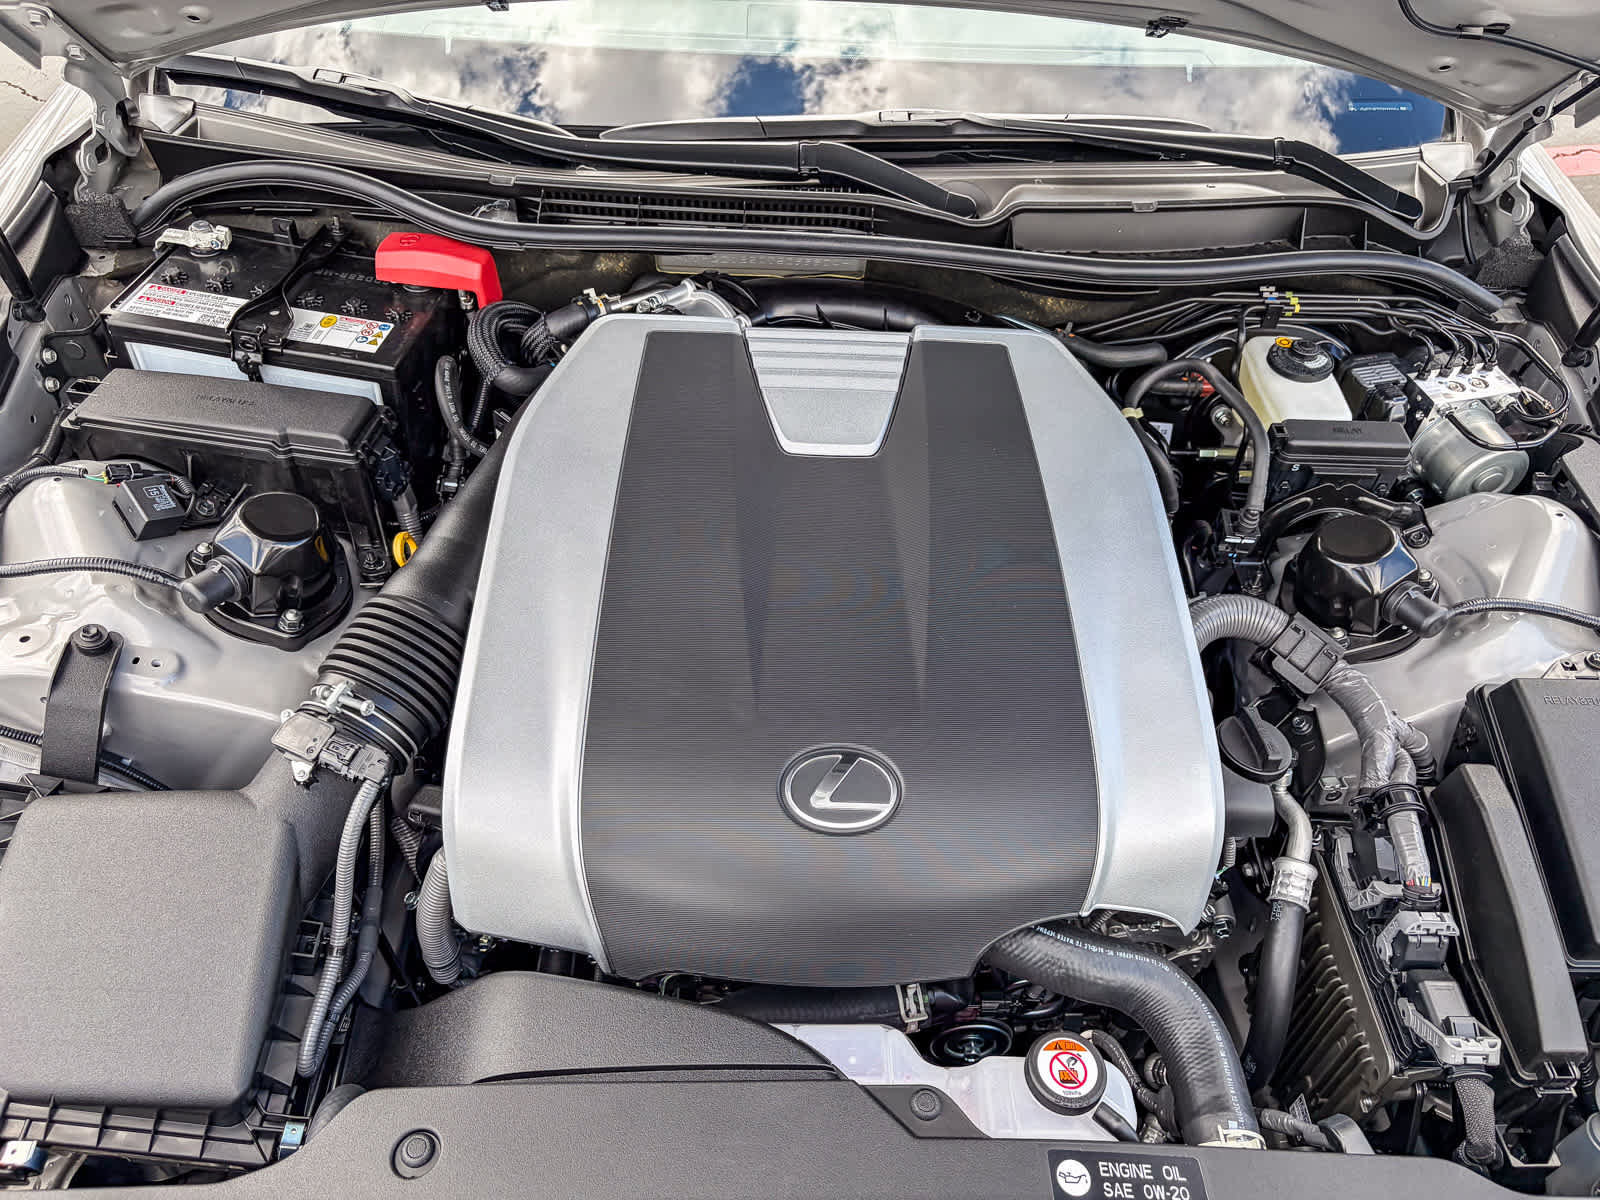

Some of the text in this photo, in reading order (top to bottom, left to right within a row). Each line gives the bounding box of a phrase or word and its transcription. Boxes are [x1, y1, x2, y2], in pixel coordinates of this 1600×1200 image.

[1098, 1161, 1187, 1182] ENGINE OIL
[1103, 1182, 1190, 1200] SAE 0W-20
